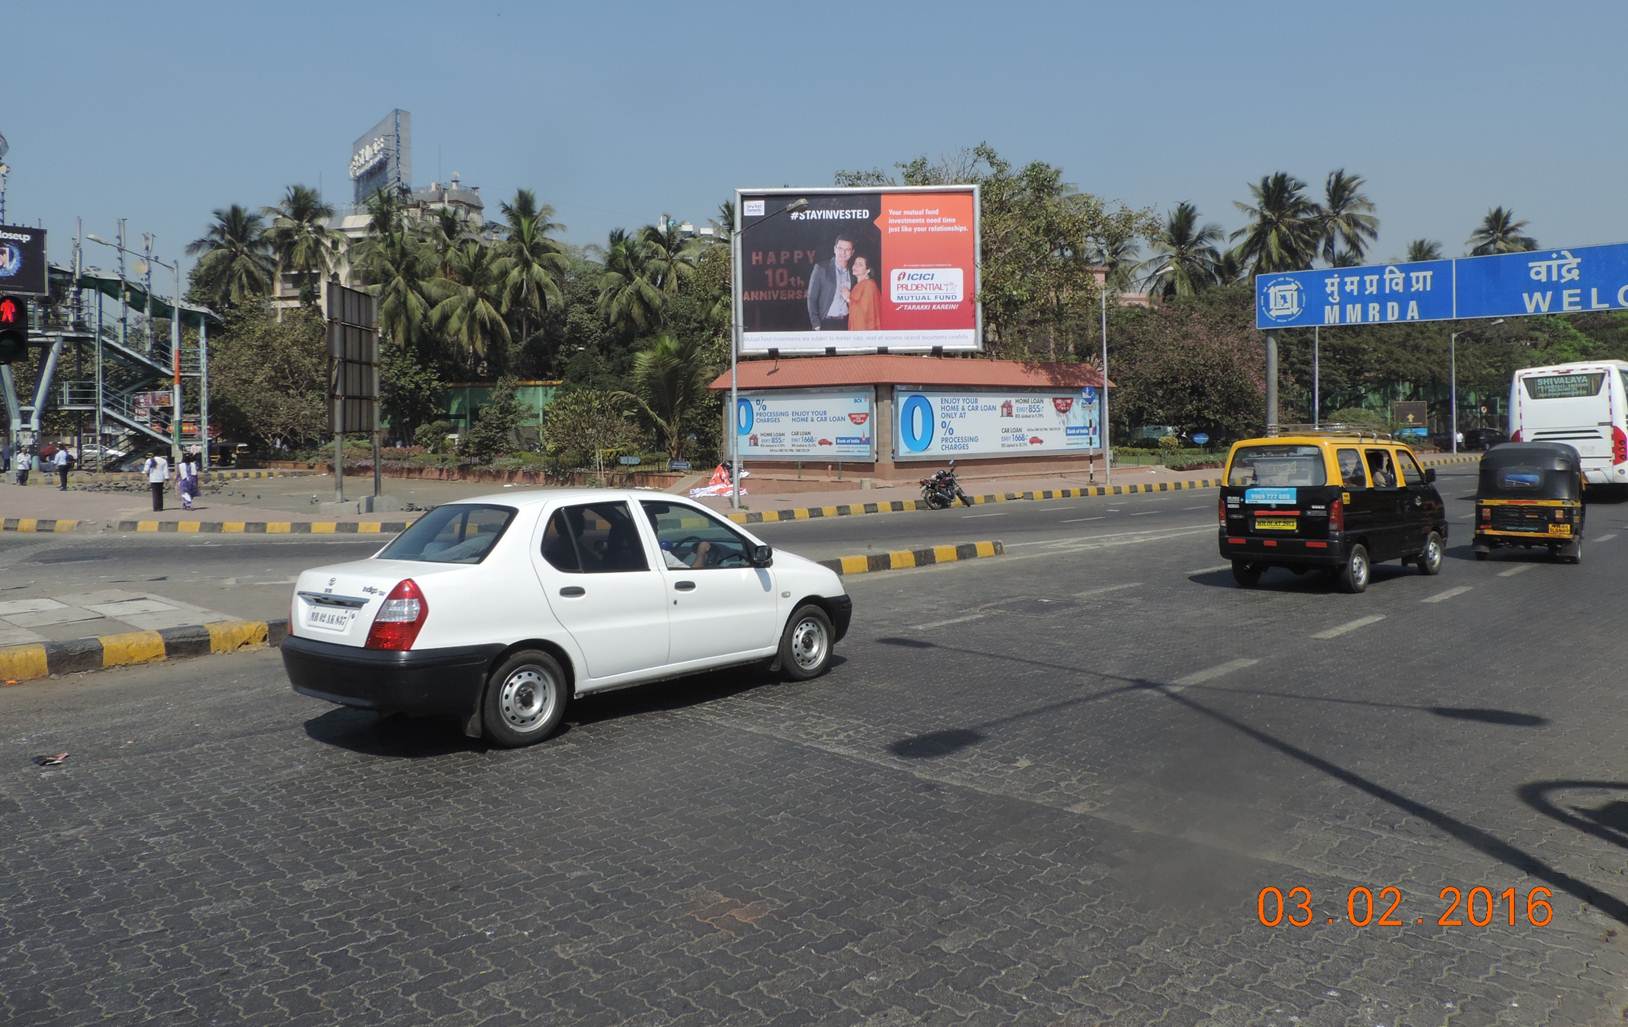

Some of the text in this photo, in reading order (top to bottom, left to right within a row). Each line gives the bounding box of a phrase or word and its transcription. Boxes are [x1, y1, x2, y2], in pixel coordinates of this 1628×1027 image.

[791, 209, 870, 220] #STAYINVESTED
[751, 250, 817, 265] HAPPY
[907, 273, 935, 281] ICICI
[896, 283, 944, 291] PRUDENTIAL
[1324, 301, 1420, 325] MMRDA
[1537, 375, 1588, 386] SHIVALAYA
[900, 395, 935, 452] 0
[940, 420, 954, 436] %
[940, 443, 970, 451] CHARGES
